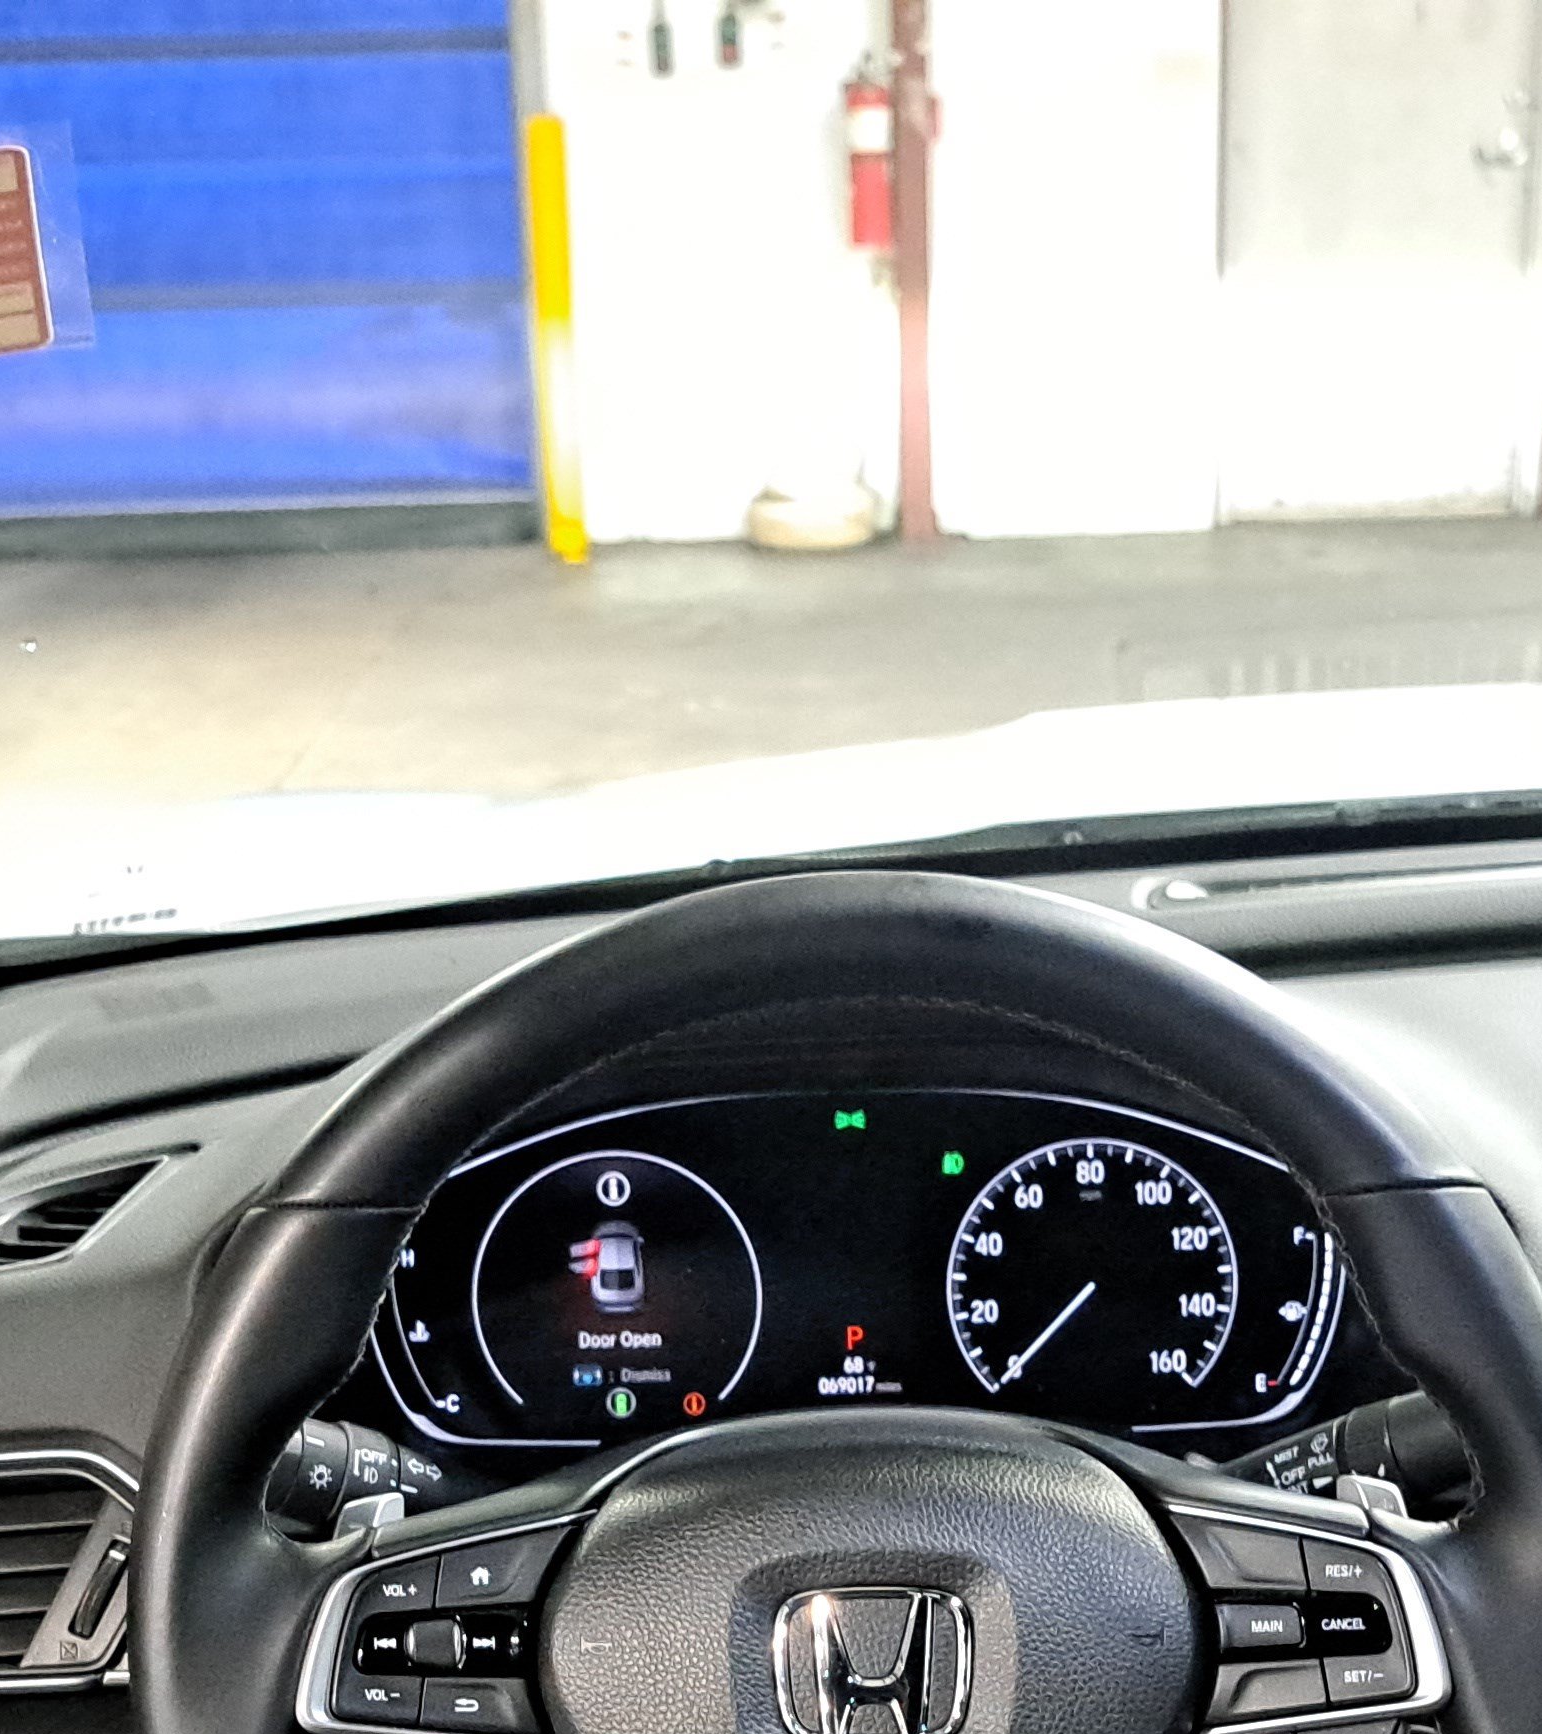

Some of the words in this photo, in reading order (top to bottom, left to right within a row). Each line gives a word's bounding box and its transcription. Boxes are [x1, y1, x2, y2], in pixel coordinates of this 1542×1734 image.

[1076, 1160, 1105, 1184] 80
[1014, 1184, 1043, 1209] 60
[1135, 1181, 1172, 1206] 100
[974, 1232, 1002, 1257] 40
[1171, 1226, 1208, 1251] 120
[1293, 1226, 1305, 1245] F
[970, 1299, 999, 1324] 20
[1178, 1293, 1215, 1317] 140
[578, 1331, 616, 1349] Door
[619, 1330, 663, 1349] Open
[846, 1325, 864, 1350] P
[843, 1356, 864, 1374] 68
[1149, 1348, 1187, 1374] 160
[818, 1376, 875, 1395] 069017
[1255, 1373, 1267, 1393] E
[445, 1394, 460, 1413] C
[360, 1449, 388, 1466] OFF
[1308, 1451, 1334, 1470] PULL
[1281, 1466, 1305, 1485] OFF
[382, 1584, 406, 1597] VOL
[1251, 1620, 1283, 1633] MAIN
[1321, 1618, 1366, 1631] CANCEL
[365, 1689, 388, 1701] VOL
